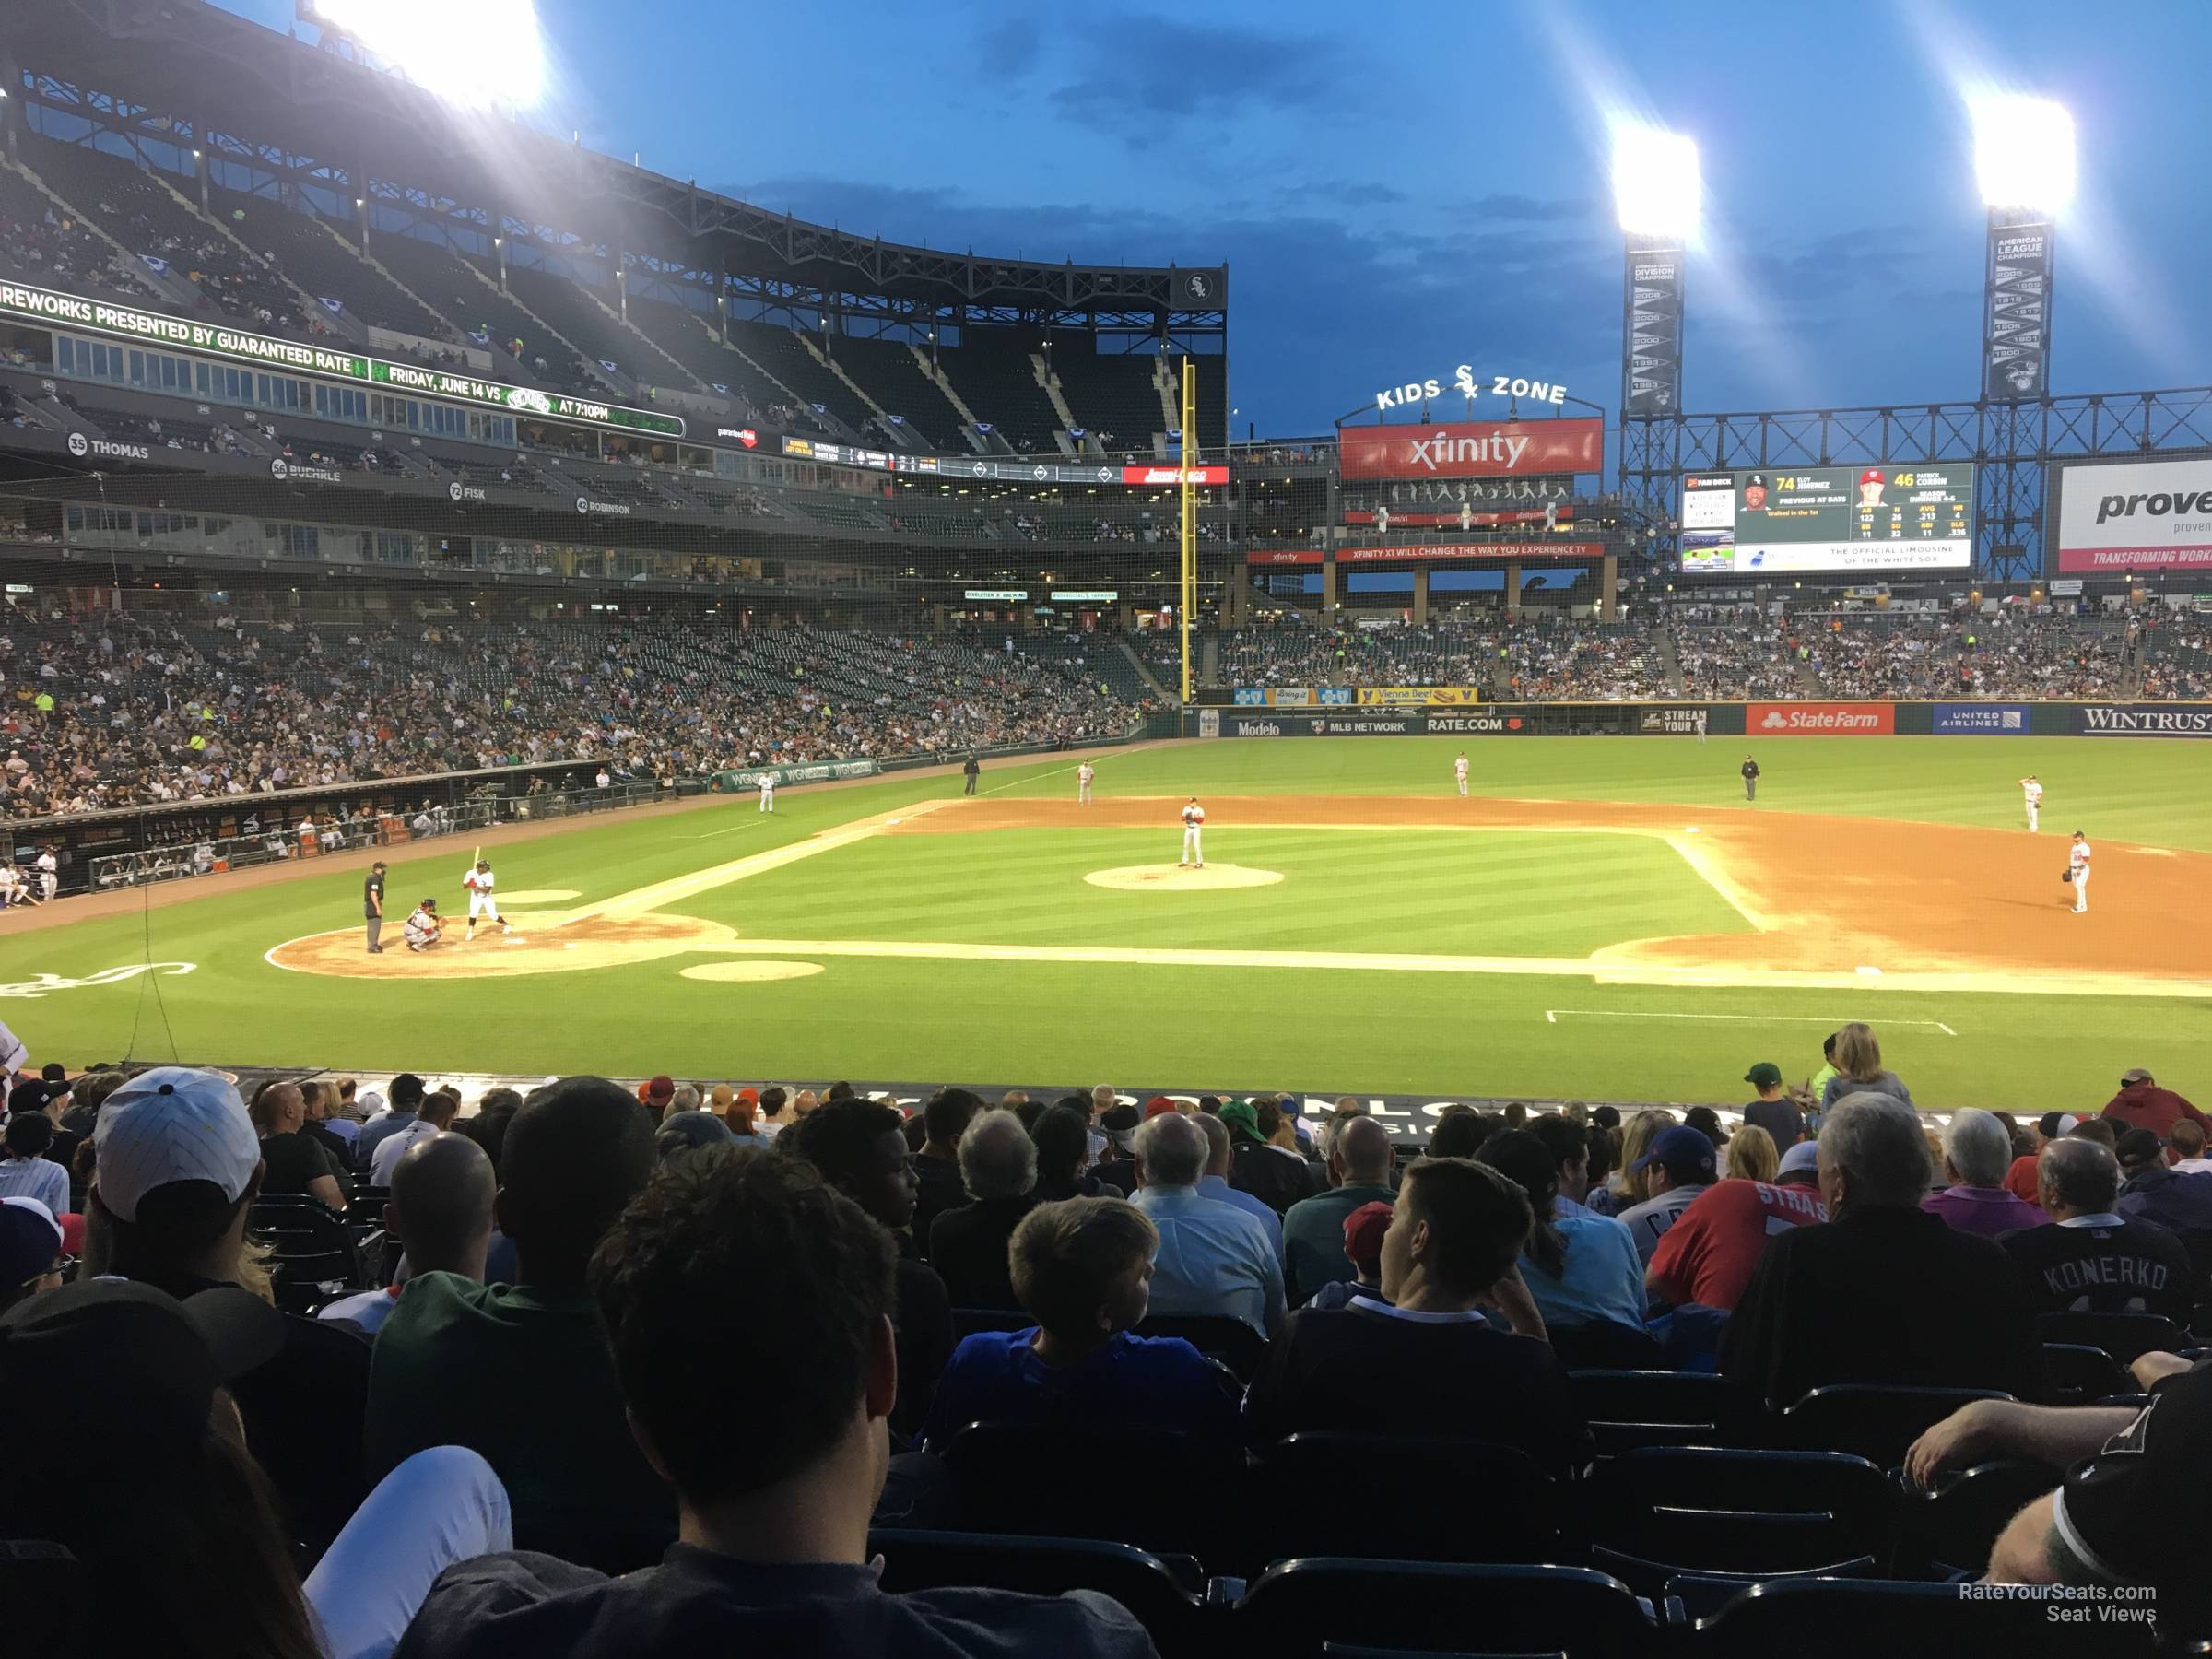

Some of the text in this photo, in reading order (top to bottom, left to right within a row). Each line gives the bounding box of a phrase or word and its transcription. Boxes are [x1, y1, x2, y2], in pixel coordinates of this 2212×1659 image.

[1998, 236, 2043, 246] AMERICAN
[1997, 243, 2043, 254] LEAGUE
[1997, 252, 2042, 261] CHAMPIONS
[1635, 267, 1675, 276] DIVISION
[95, 306, 190, 341] PRESENTED
[193, 325, 215, 346] BY
[217, 332, 313, 366] GUARANTEED
[315, 351, 352, 373] RATE
[389, 367, 437, 392] FRIDAY,
[439, 378, 469, 394] JUNE
[471, 382, 483, 397] 14
[487, 385, 501, 400] VS
[560, 399, 573, 414] AT
[575, 404, 608, 420] 7:10PM
[1377, 380, 1440, 409] KIDS
[1493, 376, 1567, 404] ZONE
[70, 438, 149, 459] 35 THOMAS
[1410, 430, 1530, 470] xfinity
[1776, 477, 1795, 491] 74
[1797, 481, 1830, 490] JIMENEZ
[1894, 473, 1914, 487] 46
[1917, 477, 1947, 486] CORBIN
[464, 488, 486, 500] FISK
[589, 501, 630, 515] ROBINSON
[1272, 553, 1298, 562] xfinity
[1353, 549, 1383, 559] XFINITY
[1396, 547, 1418, 557] WILL
[1418, 547, 1456, 556] CHANGE
[1458, 547, 1476, 555] THE
[1478, 546, 1499, 555] WAY
[1499, 546, 1520, 554] YOU
[1521, 546, 1574, 554] EXPERIENCE
[2094, 551, 2177, 564] TRANSFORMING
[1665, 710, 1707, 721] STREAM
[1238, 721, 1280, 737] Modelo
[1329, 723, 1406, 732] MLB NETWORK
[1428, 719, 1503, 731] RATE.COM
[1665, 721, 1692, 732] YOUR
[1940, 719, 2000, 727] AIRLINES
[2043, 1256, 2167, 1293] KONERKO
